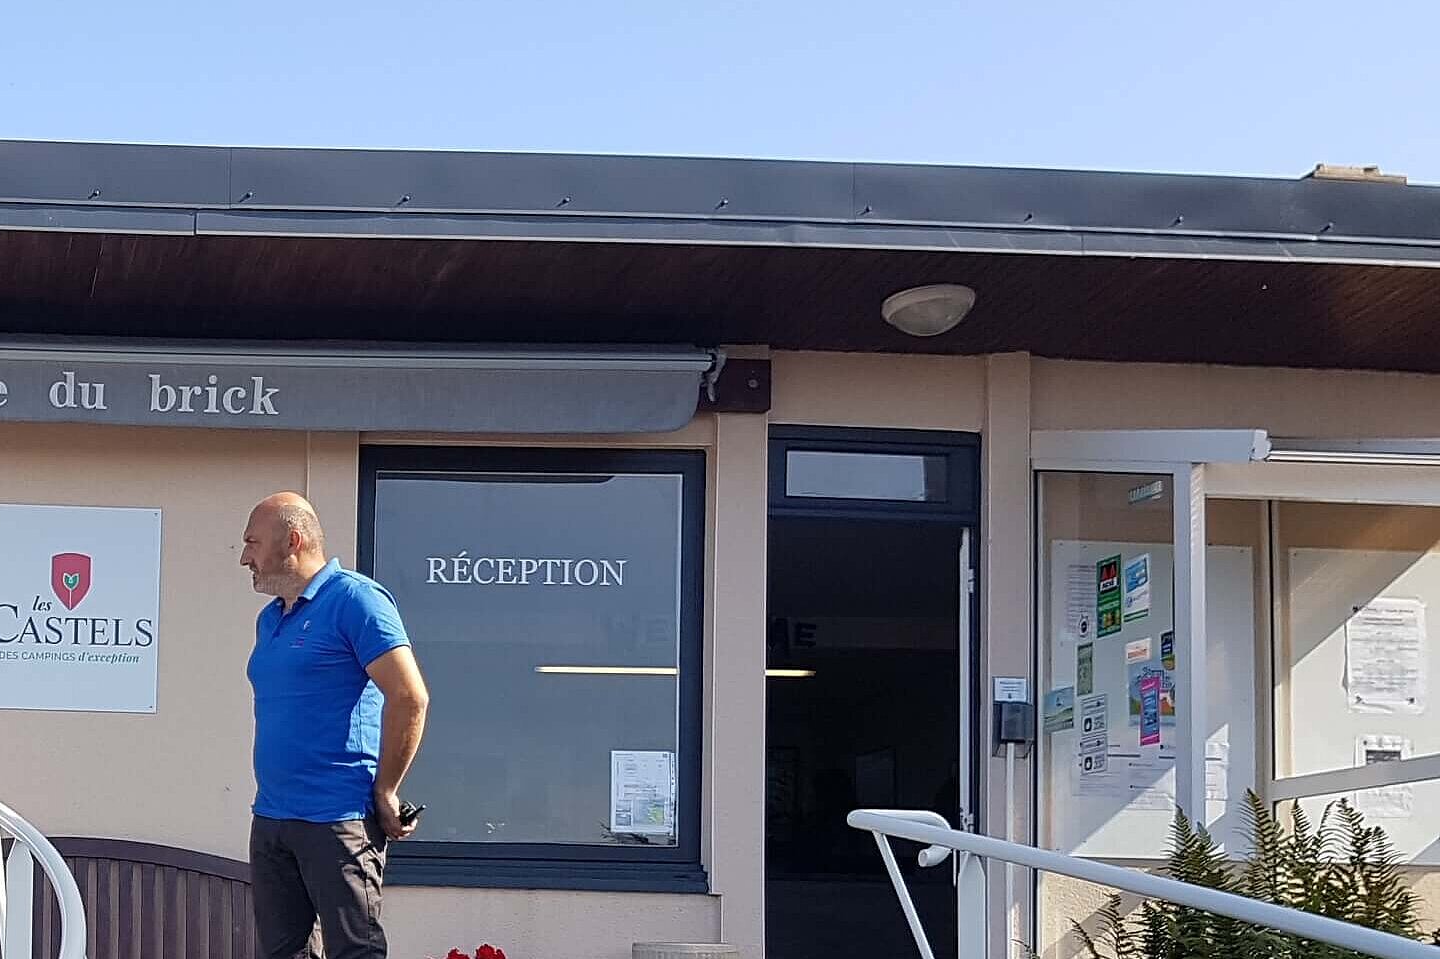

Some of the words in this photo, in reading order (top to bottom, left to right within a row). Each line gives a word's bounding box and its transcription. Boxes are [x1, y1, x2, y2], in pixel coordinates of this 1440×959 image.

[49, 371, 108, 410] du
[148, 374, 279, 416] brick
[426, 551, 627, 586] RÉCEPTION
[32, 596, 53, 612] les
[21, 651, 76, 662] CAMPINGS
[78, 651, 140, 664] d'exception
